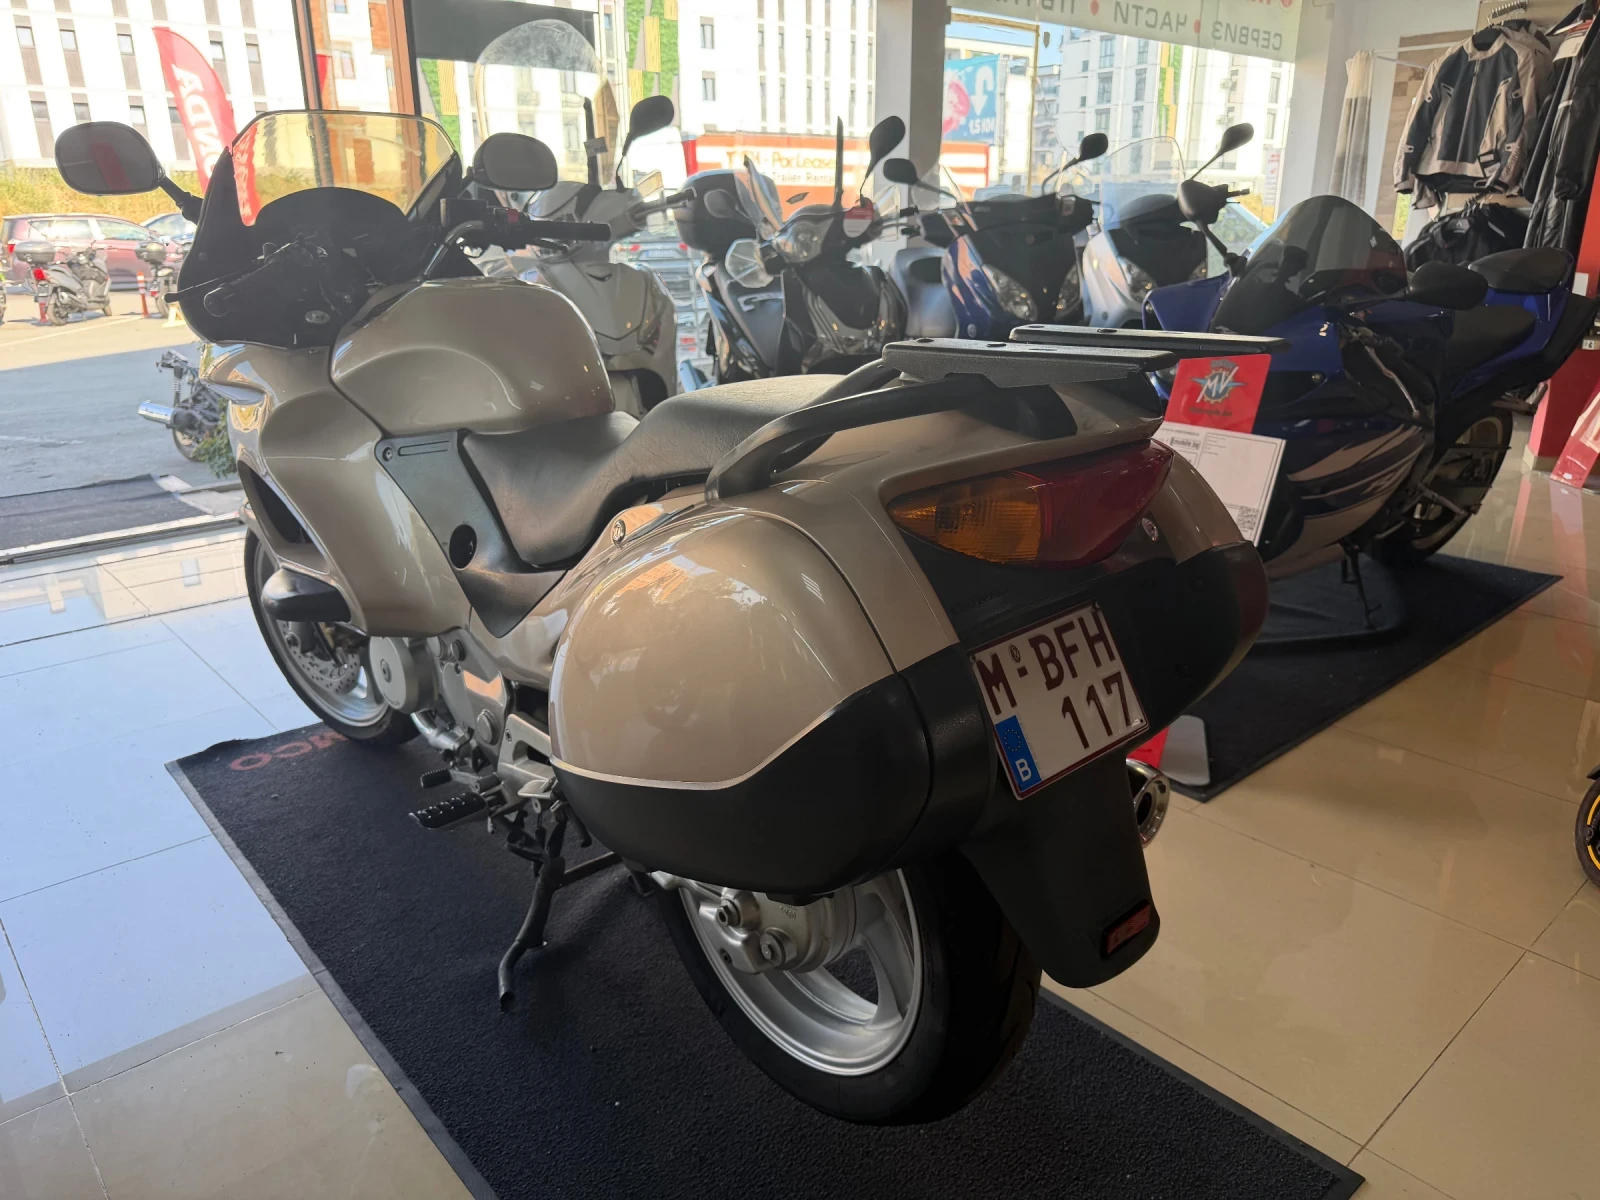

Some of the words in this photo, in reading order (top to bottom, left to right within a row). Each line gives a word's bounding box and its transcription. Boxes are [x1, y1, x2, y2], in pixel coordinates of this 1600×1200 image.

[1195, 366, 1240, 404] MV
[1061, 671, 1131, 750] 117
[1015, 758, 1032, 782] B
